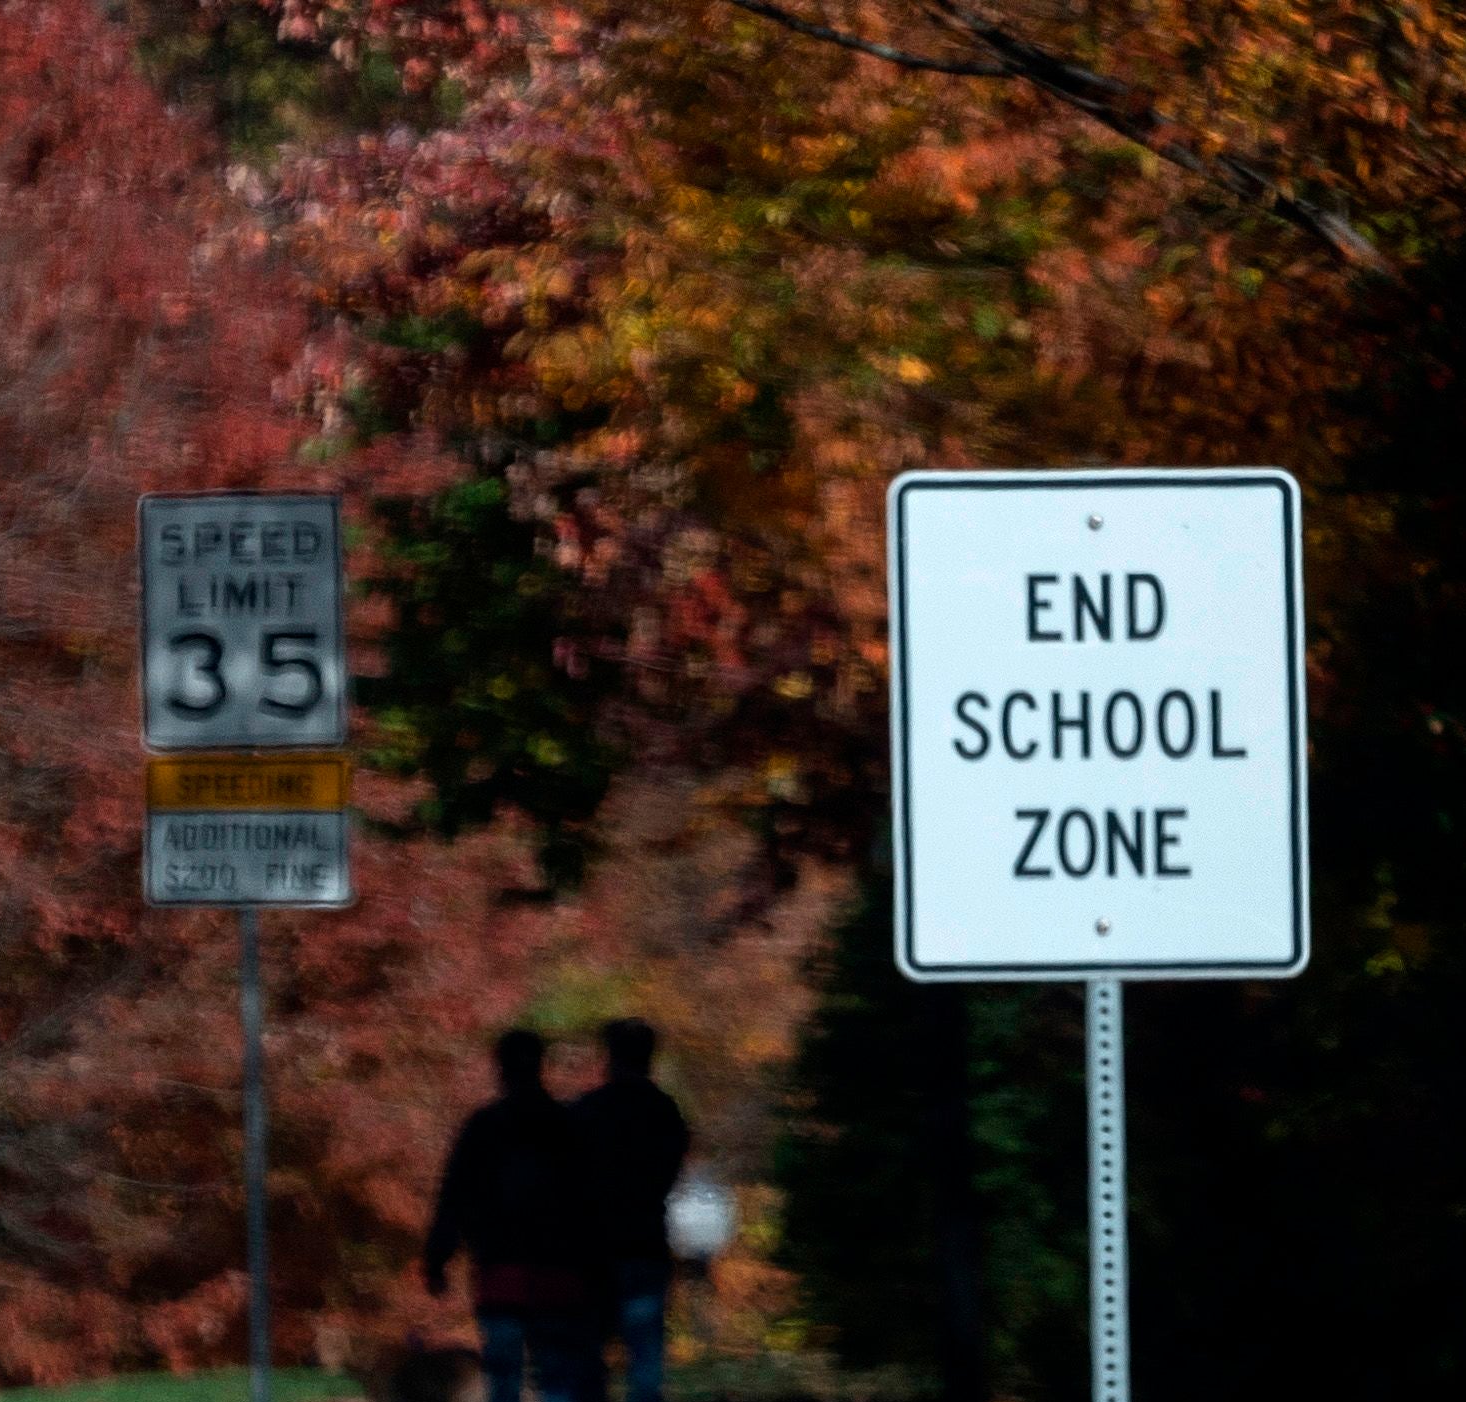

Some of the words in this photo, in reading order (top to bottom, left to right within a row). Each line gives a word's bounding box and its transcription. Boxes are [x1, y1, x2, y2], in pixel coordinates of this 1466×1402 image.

[159, 520, 322, 566] SPEED
[177, 573, 305, 616] LIMIT
[1025, 572, 1166, 643] END
[166, 626, 323, 720] 35
[951, 688, 1247, 761] SCHOOL
[176, 772, 315, 800] SPEEDING
[163, 821, 334, 853] ADDITIONAL
[1012, 807, 1192, 879] ZONE
[265, 860, 329, 891] FINE
